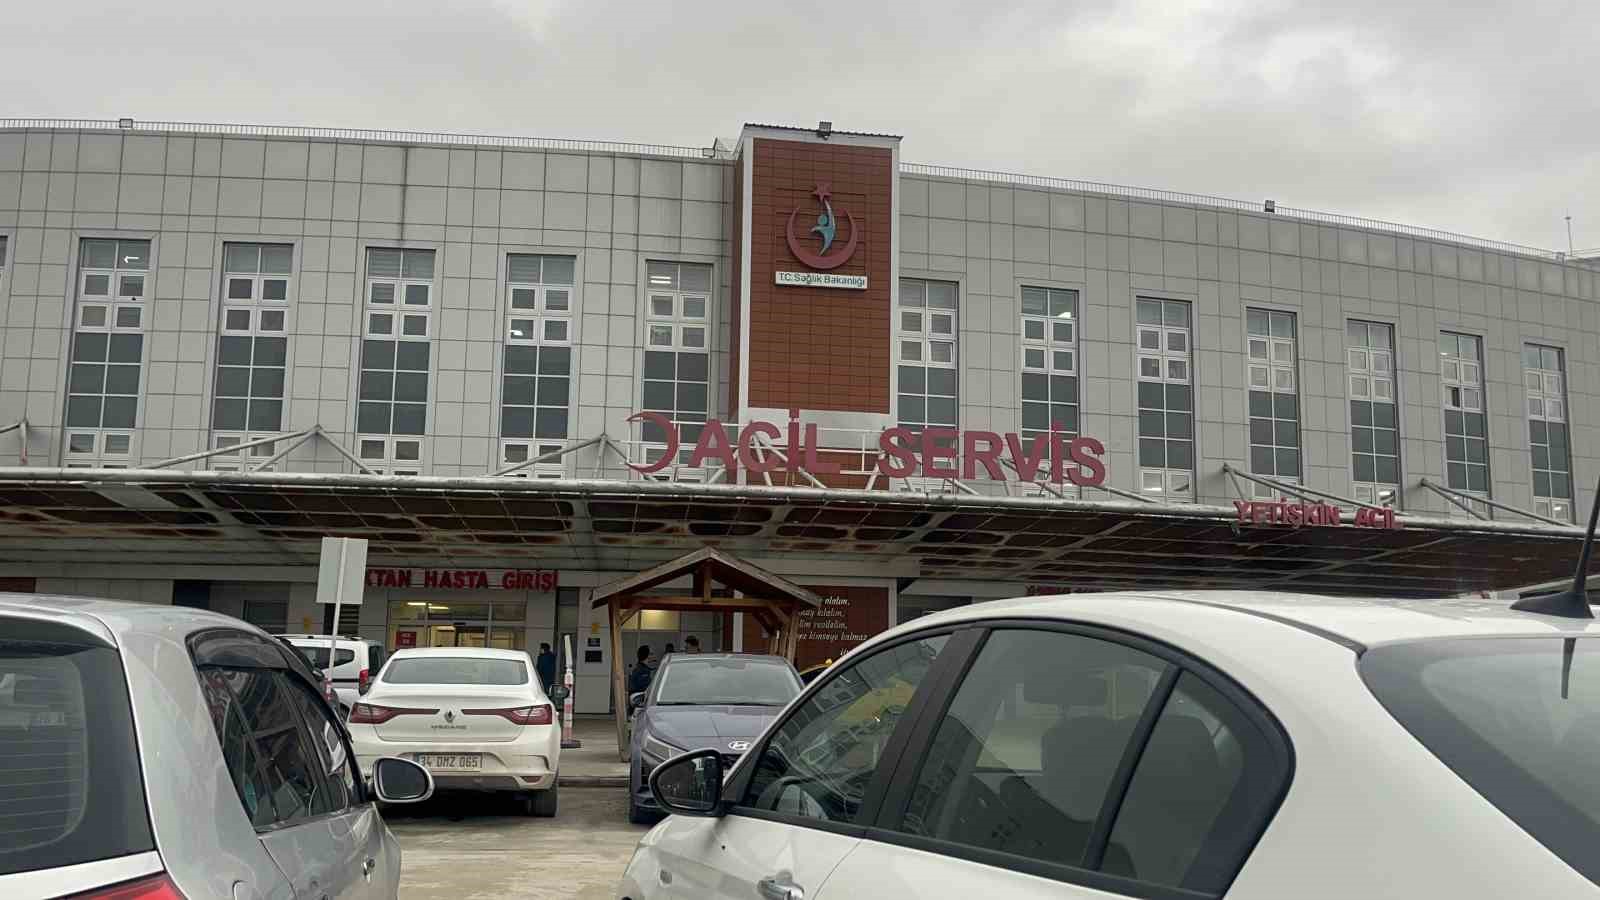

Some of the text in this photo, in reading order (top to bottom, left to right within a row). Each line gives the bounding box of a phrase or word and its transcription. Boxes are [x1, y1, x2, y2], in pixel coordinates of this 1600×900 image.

[688, 408, 1106, 486] ACİL SERVİS
[1233, 497, 1341, 527] YETİŞKİN
[425, 569, 488, 589] HASTA
[419, 756, 478, 768] 34 DMZ 065
